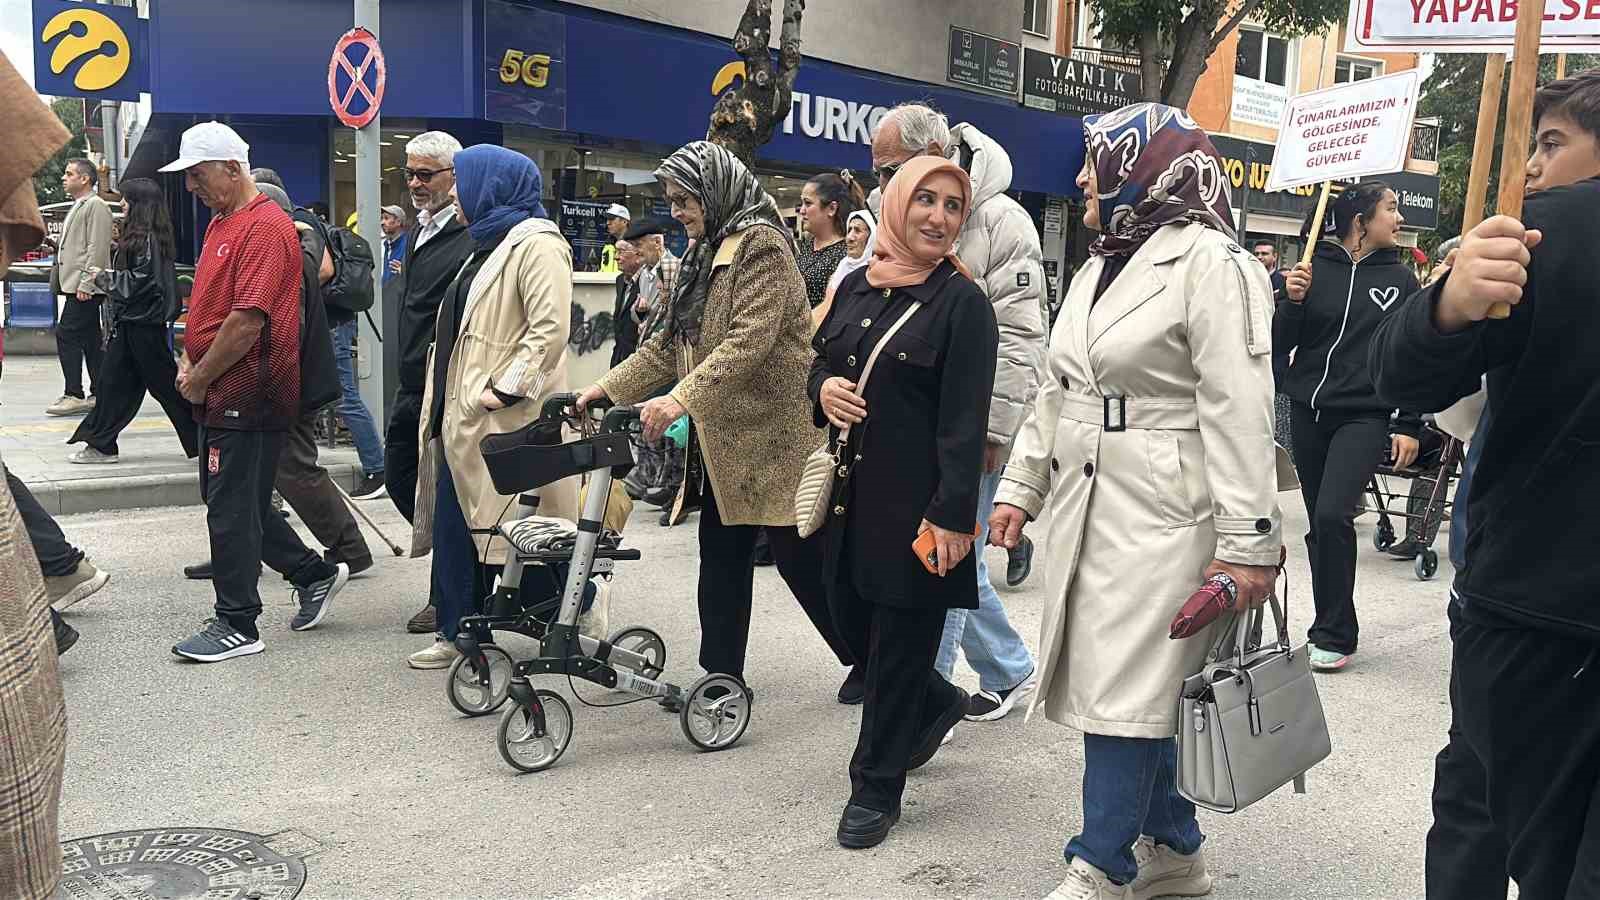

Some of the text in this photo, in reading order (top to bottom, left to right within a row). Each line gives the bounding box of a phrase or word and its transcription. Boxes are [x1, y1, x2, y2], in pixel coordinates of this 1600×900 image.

[1410, 0, 1600, 23] YAPABLSE
[499, 48, 550, 88] 5G
[1050, 56, 1126, 92] YANIK
[1035, 77, 1101, 103] FOTOĞRAFÇILIK
[783, 91, 890, 146] TURKC
[1297, 97, 1396, 127] ÇINARLARIMIZIN
[1308, 133, 1368, 153] GELECEĞE
[1306, 150, 1361, 168] GÜVENLE
[562, 204, 596, 217] Turkcell
[1402, 190, 1433, 209] Telekom
